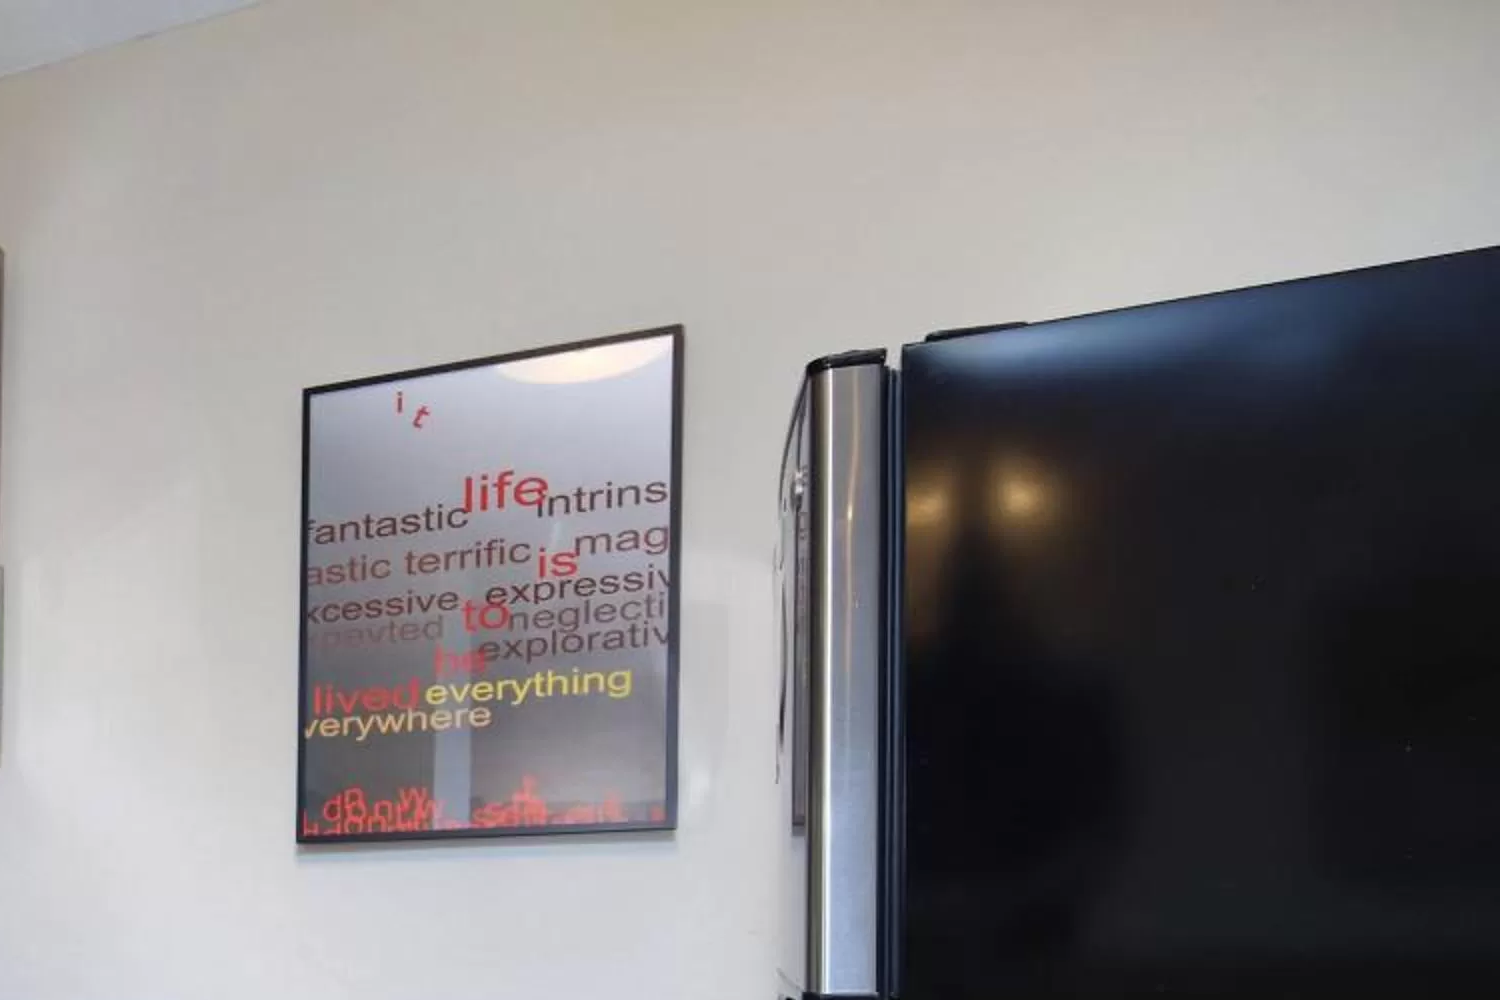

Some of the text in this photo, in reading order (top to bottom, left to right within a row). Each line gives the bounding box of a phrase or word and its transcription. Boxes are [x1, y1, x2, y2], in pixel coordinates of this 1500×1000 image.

[464, 469, 549, 513] life
[404, 538, 532, 576] terrific
[574, 525, 670, 556] mag
[538, 546, 579, 579] is
[461, 599, 510, 633] to
[313, 666, 633, 716] lived everything
